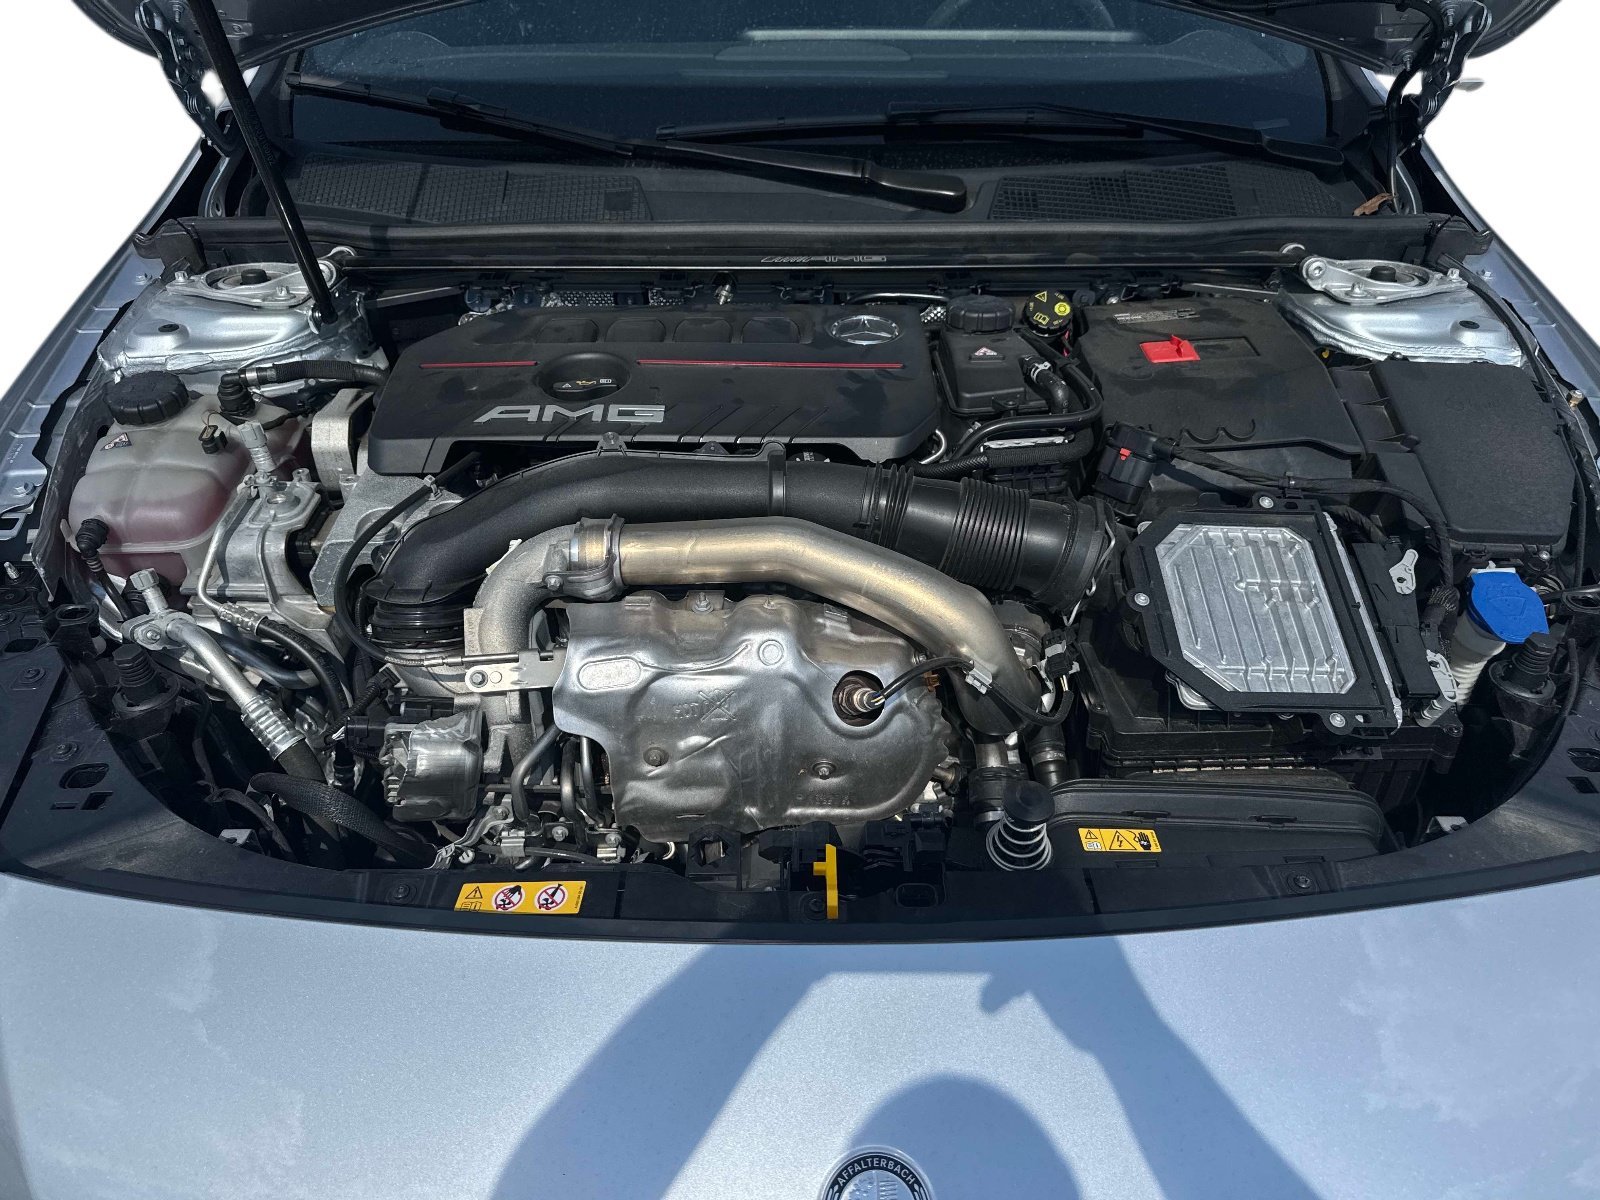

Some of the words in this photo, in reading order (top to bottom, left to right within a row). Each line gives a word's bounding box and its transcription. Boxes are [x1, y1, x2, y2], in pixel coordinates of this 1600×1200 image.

[803, 255, 887, 263] AMG
[473, 404, 666, 424] AMG
[836, 1157, 916, 1187] AFFALTERBACH
